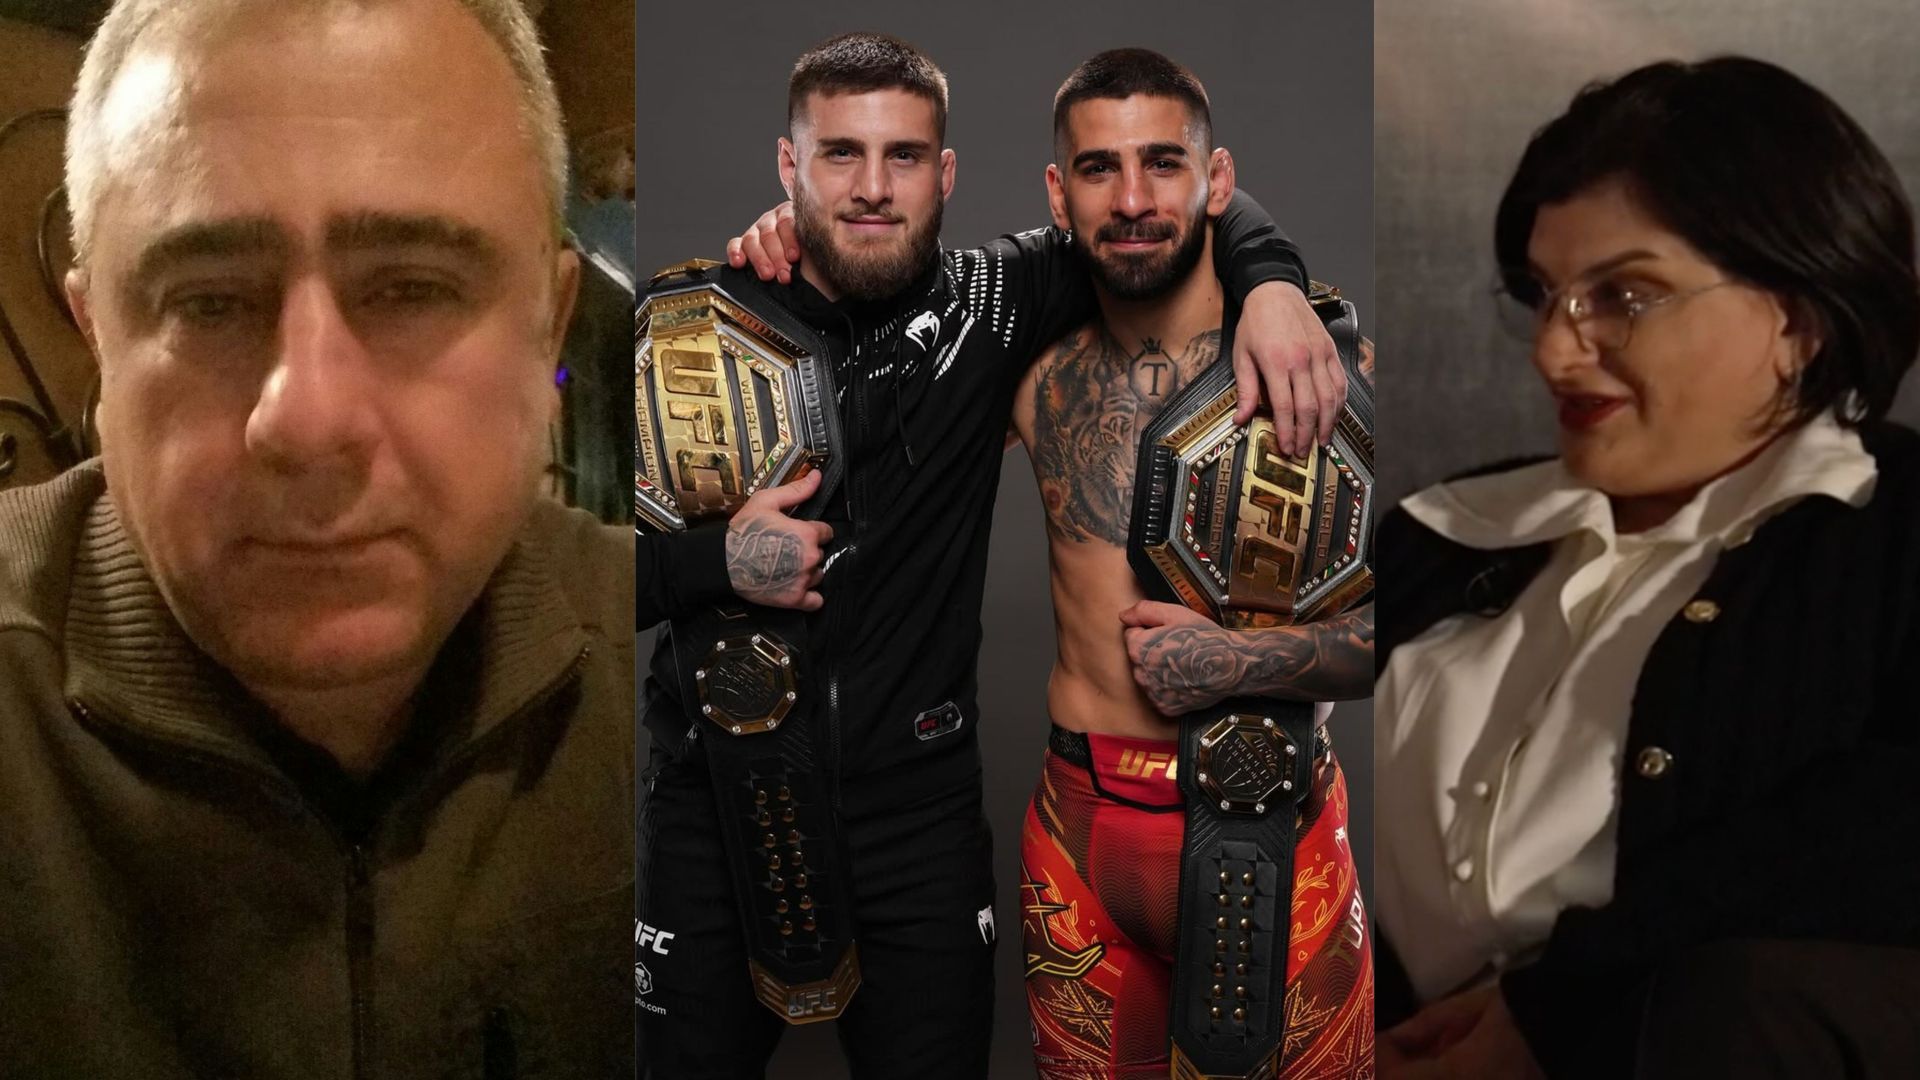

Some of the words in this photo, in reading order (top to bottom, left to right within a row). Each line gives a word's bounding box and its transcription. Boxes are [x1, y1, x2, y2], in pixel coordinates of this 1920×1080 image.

[740, 379, 762, 452] WORLD
[1140, 362, 1168, 396] T
[660, 349, 741, 495] UFC
[1210, 457, 1232, 555] CHAMPION
[1239, 429, 1310, 593] UFC
[1317, 484, 1337, 558] WORLD
[787, 988, 837, 1017] UFC
